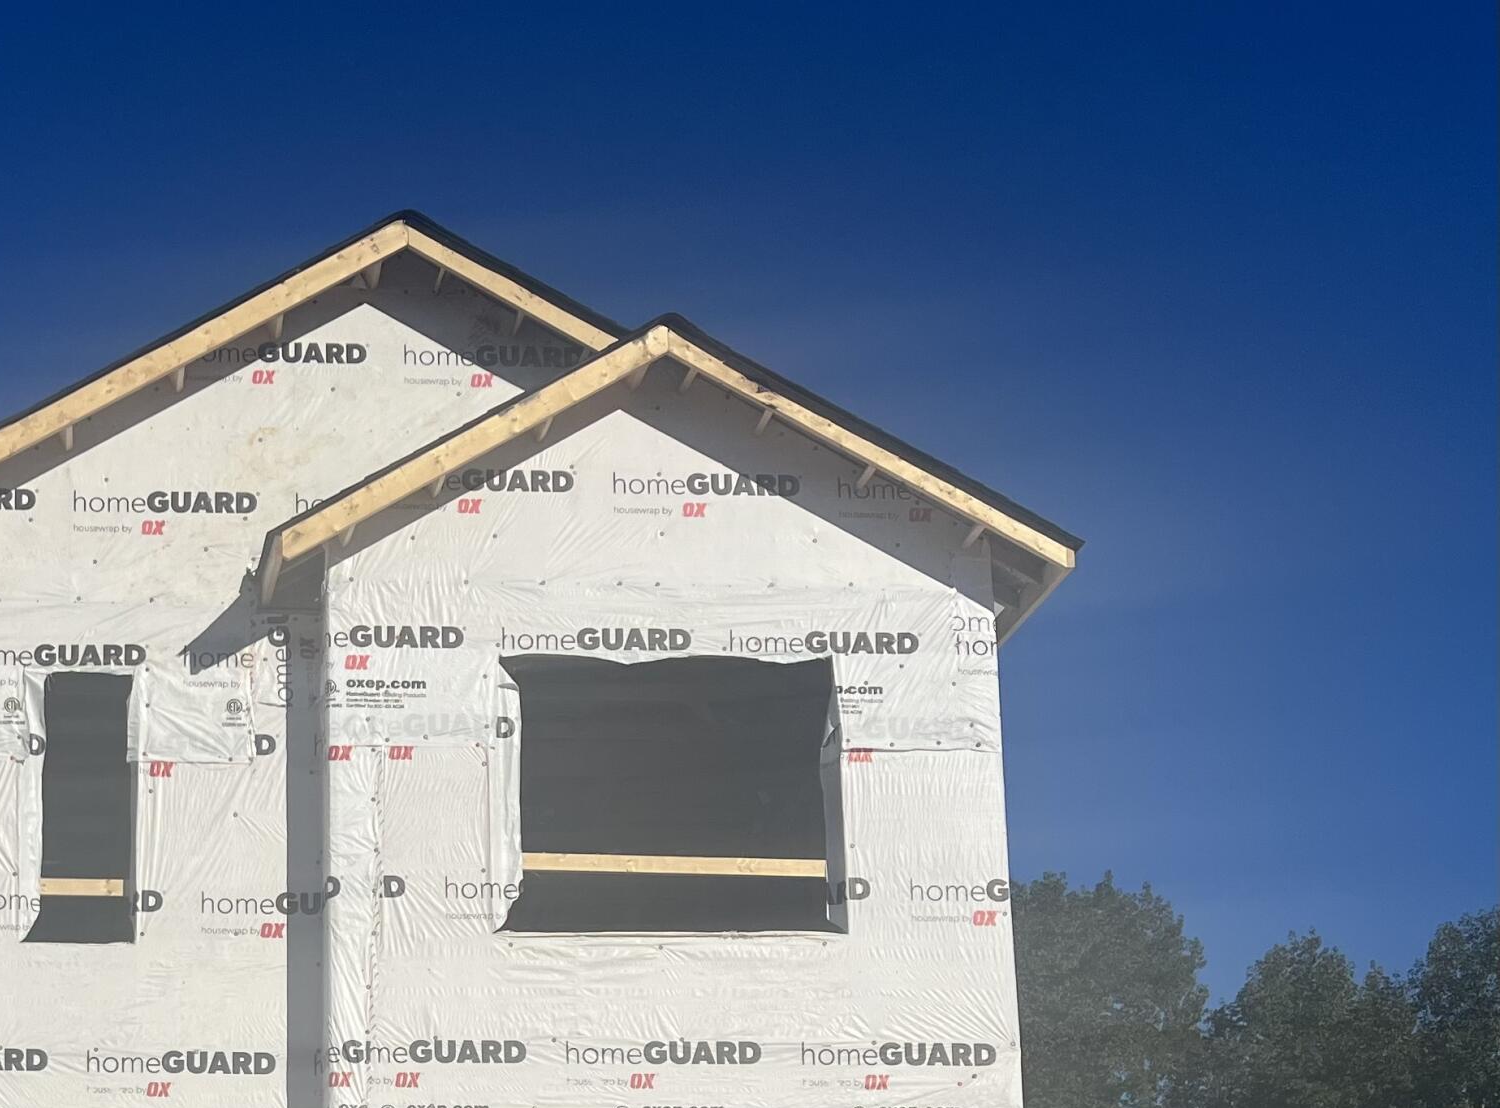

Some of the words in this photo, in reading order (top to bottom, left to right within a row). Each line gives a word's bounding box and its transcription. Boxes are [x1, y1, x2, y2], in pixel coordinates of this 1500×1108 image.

[252, 370, 274, 384] OX
[471, 373, 492, 388] OX
[613, 472, 799, 496] homeGUARD
[73, 490, 258, 514] homeGUARD
[457, 499, 481, 514] OX
[683, 503, 706, 517] OX
[909, 508, 932, 522] OX
[141, 520, 165, 535] OX
[501, 628, 691, 651] homeGUARD
[730, 632, 919, 655] homeGUARD
[344, 655, 370, 670] OX
[346, 679, 426, 692] oxep.com
[328, 746, 352, 761] OX
[389, 746, 413, 760] OX
[149, 762, 174, 777] OX
[973, 910, 997, 926] OX
[260, 923, 285, 938] OX
[566, 1040, 761, 1065] homeGUARD
[801, 1042, 996, 1066] homeGUARD
[86, 1049, 276, 1075] homeGUARD
[329, 1072, 352, 1088] OX
[394, 1072, 420, 1088] OX
[630, 1073, 655, 1089] OX
[864, 1074, 890, 1090] OX
[147, 1082, 171, 1098] OX
